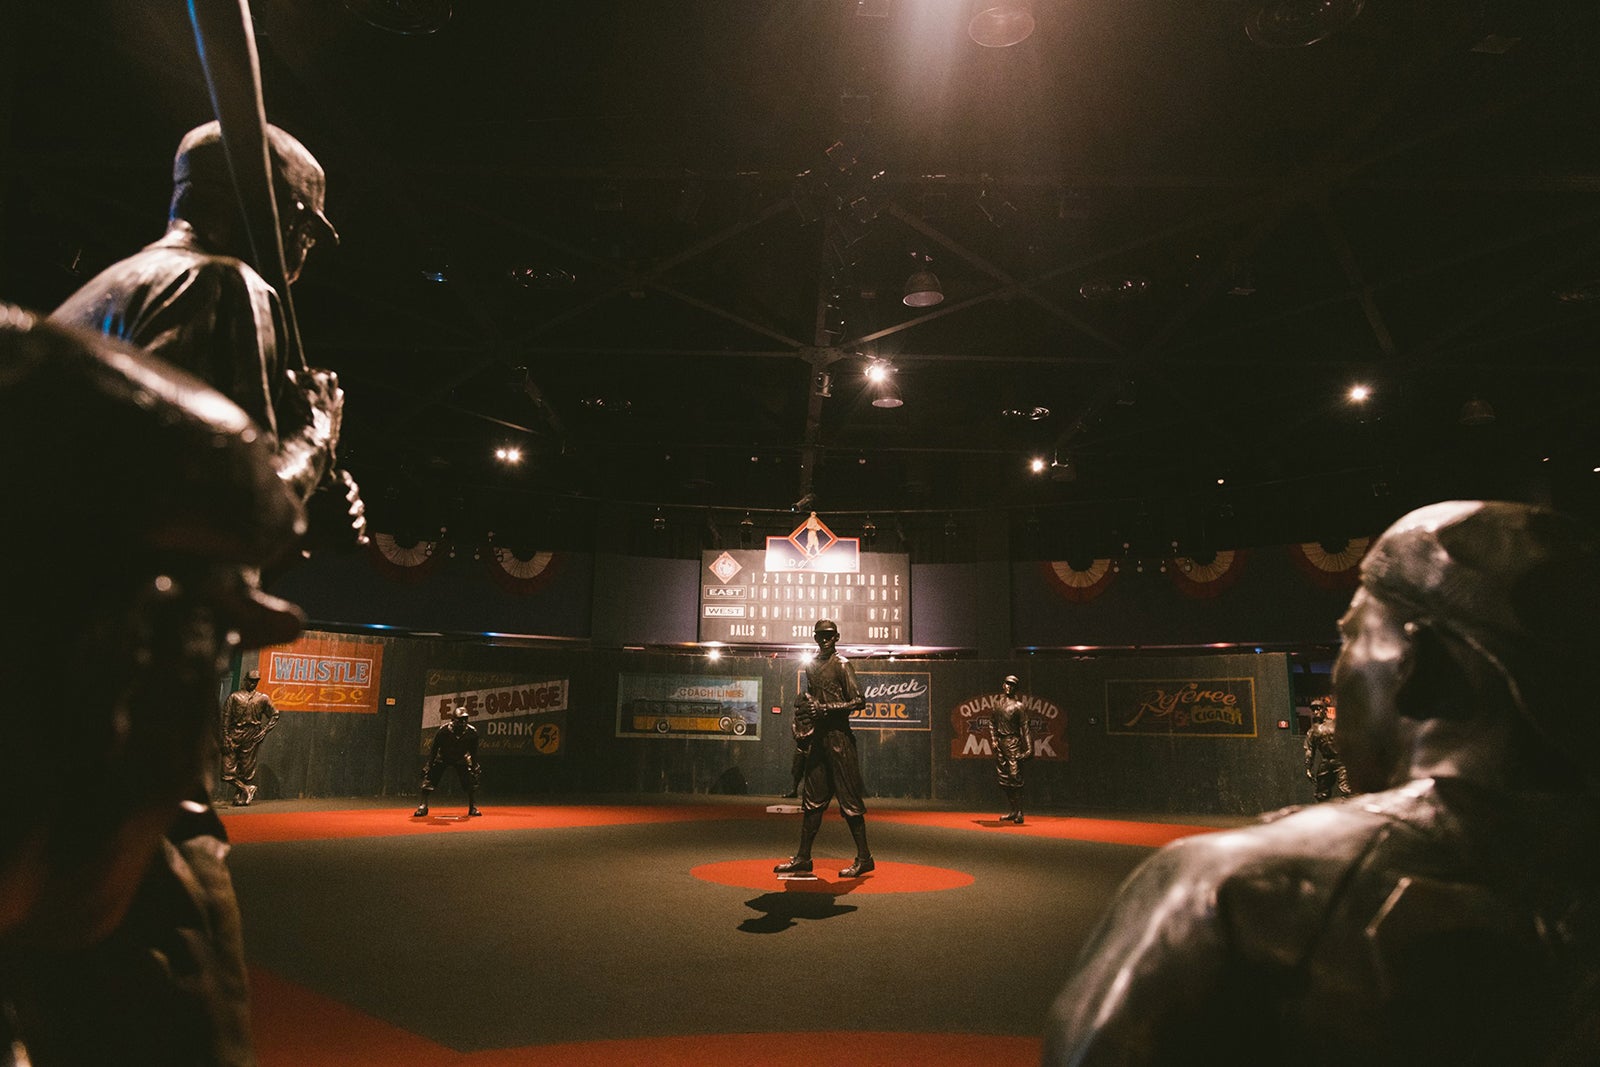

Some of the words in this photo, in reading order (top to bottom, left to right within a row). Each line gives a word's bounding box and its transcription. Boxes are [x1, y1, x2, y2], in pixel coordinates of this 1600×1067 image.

[752, 573, 755, 584] 1
[762, 573, 768, 584] 2
[774, 573, 779, 584] 3
[786, 573, 792, 584] 4
[798, 573, 804, 584] 5
[823, 574, 828, 585] 7
[846, 574, 851, 585] 9
[857, 574, 865, 585] 10
[894, 575, 899, 586] E
[751, 588, 755, 598] 1
[762, 588, 767, 599] 0
[775, 588, 778, 599] 1
[786, 588, 791, 599] 1
[822, 589, 827, 599] 0
[834, 589, 839, 599] 1
[882, 589, 887, 600] 9
[894, 590, 898, 600] 1
[750, 606, 754, 617] 0
[762, 607, 767, 618] 0
[774, 607, 779, 618] 0
[786, 607, 790, 618] 1
[798, 607, 802, 618] 1
[810, 607, 815, 618] 3
[882, 608, 887, 619] 7
[894, 609, 899, 619] 2
[730, 624, 755, 636] BALLS
[761, 625, 766, 637] 3
[868, 627, 889, 639] OUTS
[895, 628, 899, 639] 1
[274, 656, 369, 684] WHISTLE
[271, 685, 314, 706] Only
[679, 688, 714, 698] COACH
[717, 688, 744, 698] LINES
[1022, 695, 1059, 719] MAID
[1124, 683, 1237, 727] Referee
[487, 721, 534, 735] DRINK
[539, 726, 558, 749] 5¢
[962, 733, 1057, 757] MK
